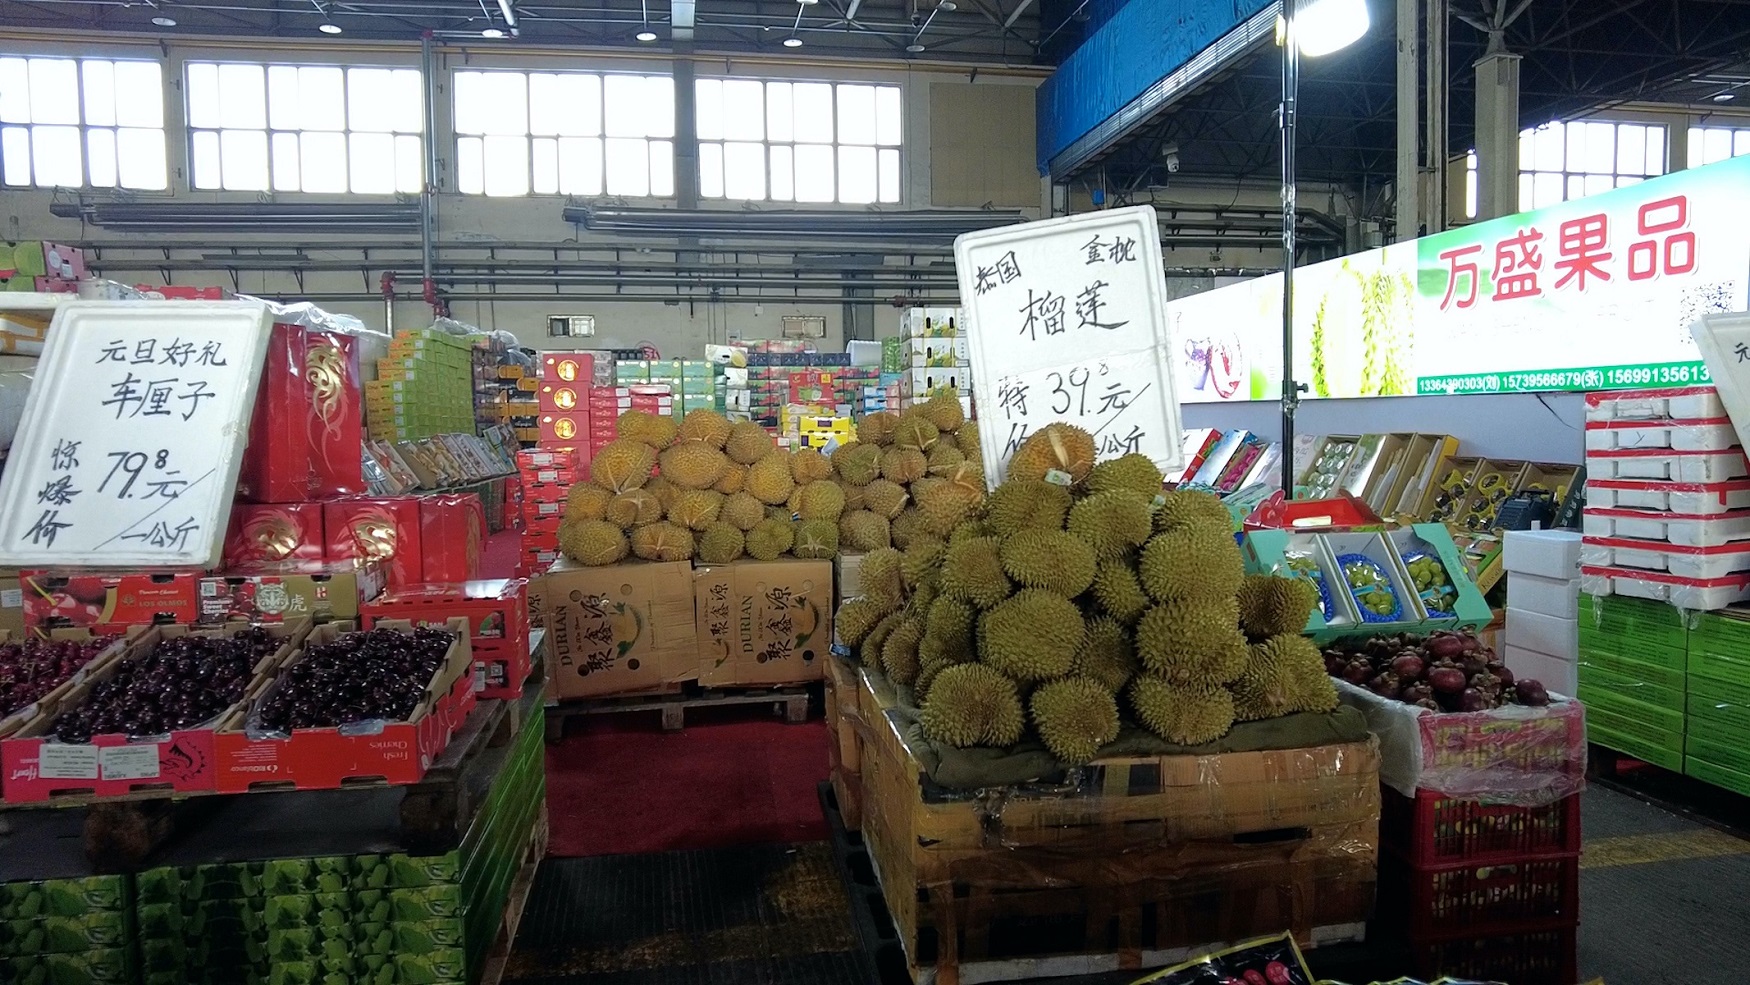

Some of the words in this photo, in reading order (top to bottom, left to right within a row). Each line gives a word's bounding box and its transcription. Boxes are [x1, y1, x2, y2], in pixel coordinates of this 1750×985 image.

[974, 250, 1022, 296] 泰国
[1080, 234, 1136, 265] 金枕
[1440, 195, 1695, 311] 万盛果品
[1018, 280, 1130, 341] 榴莲
[95, 337, 228, 367] 元旦好礼
[1607, 363, 1711, 386] 15699135613
[102, 372, 216, 421] 车厘子
[22, 438, 82, 548] 惊爆价
[289, 593, 308, 612] 虎
[710, 583, 729, 637] 聚鑫源
[741, 595, 755, 653] DURIAN
[764, 586, 792, 660] 聚鑫源
[555, 605, 573, 666] DURIAN
[581, 592, 615, 674] 聚鑫源
[369, 741, 408, 749] Cherries
[383, 751, 408, 760] Fresh
